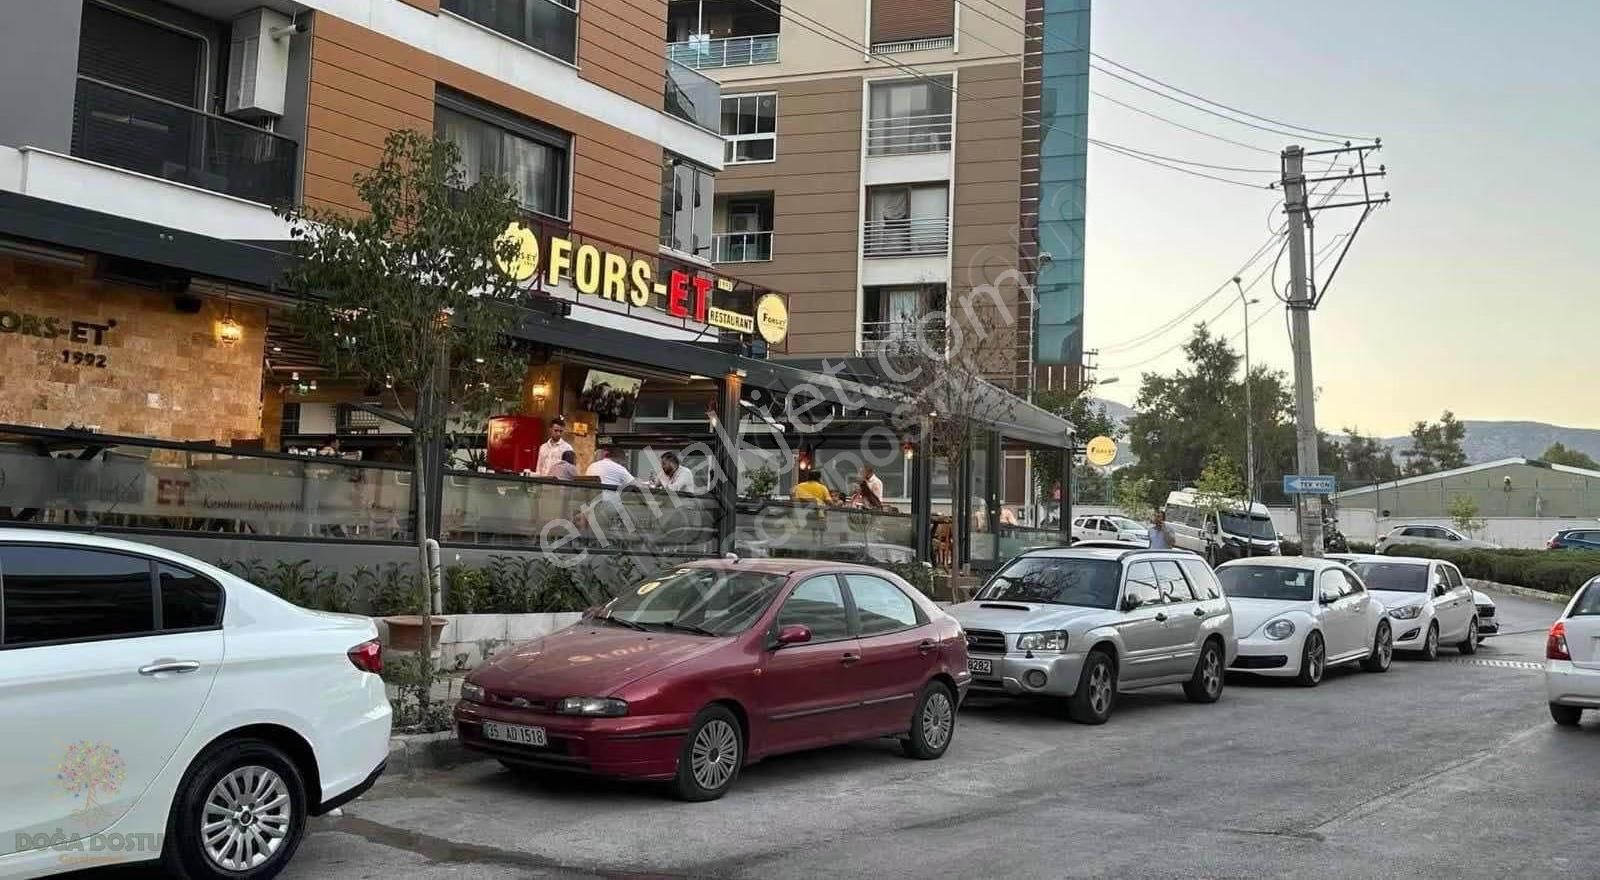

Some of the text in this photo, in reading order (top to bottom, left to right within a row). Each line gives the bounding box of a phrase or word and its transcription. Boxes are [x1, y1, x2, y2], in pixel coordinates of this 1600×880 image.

[548, 236, 714, 323] FORS-ET
[710, 310, 753, 331] RESTAURANT
[62, 349, 107, 368] 1992
[157, 477, 191, 506] ET
[520, 728, 544, 744] 1518
